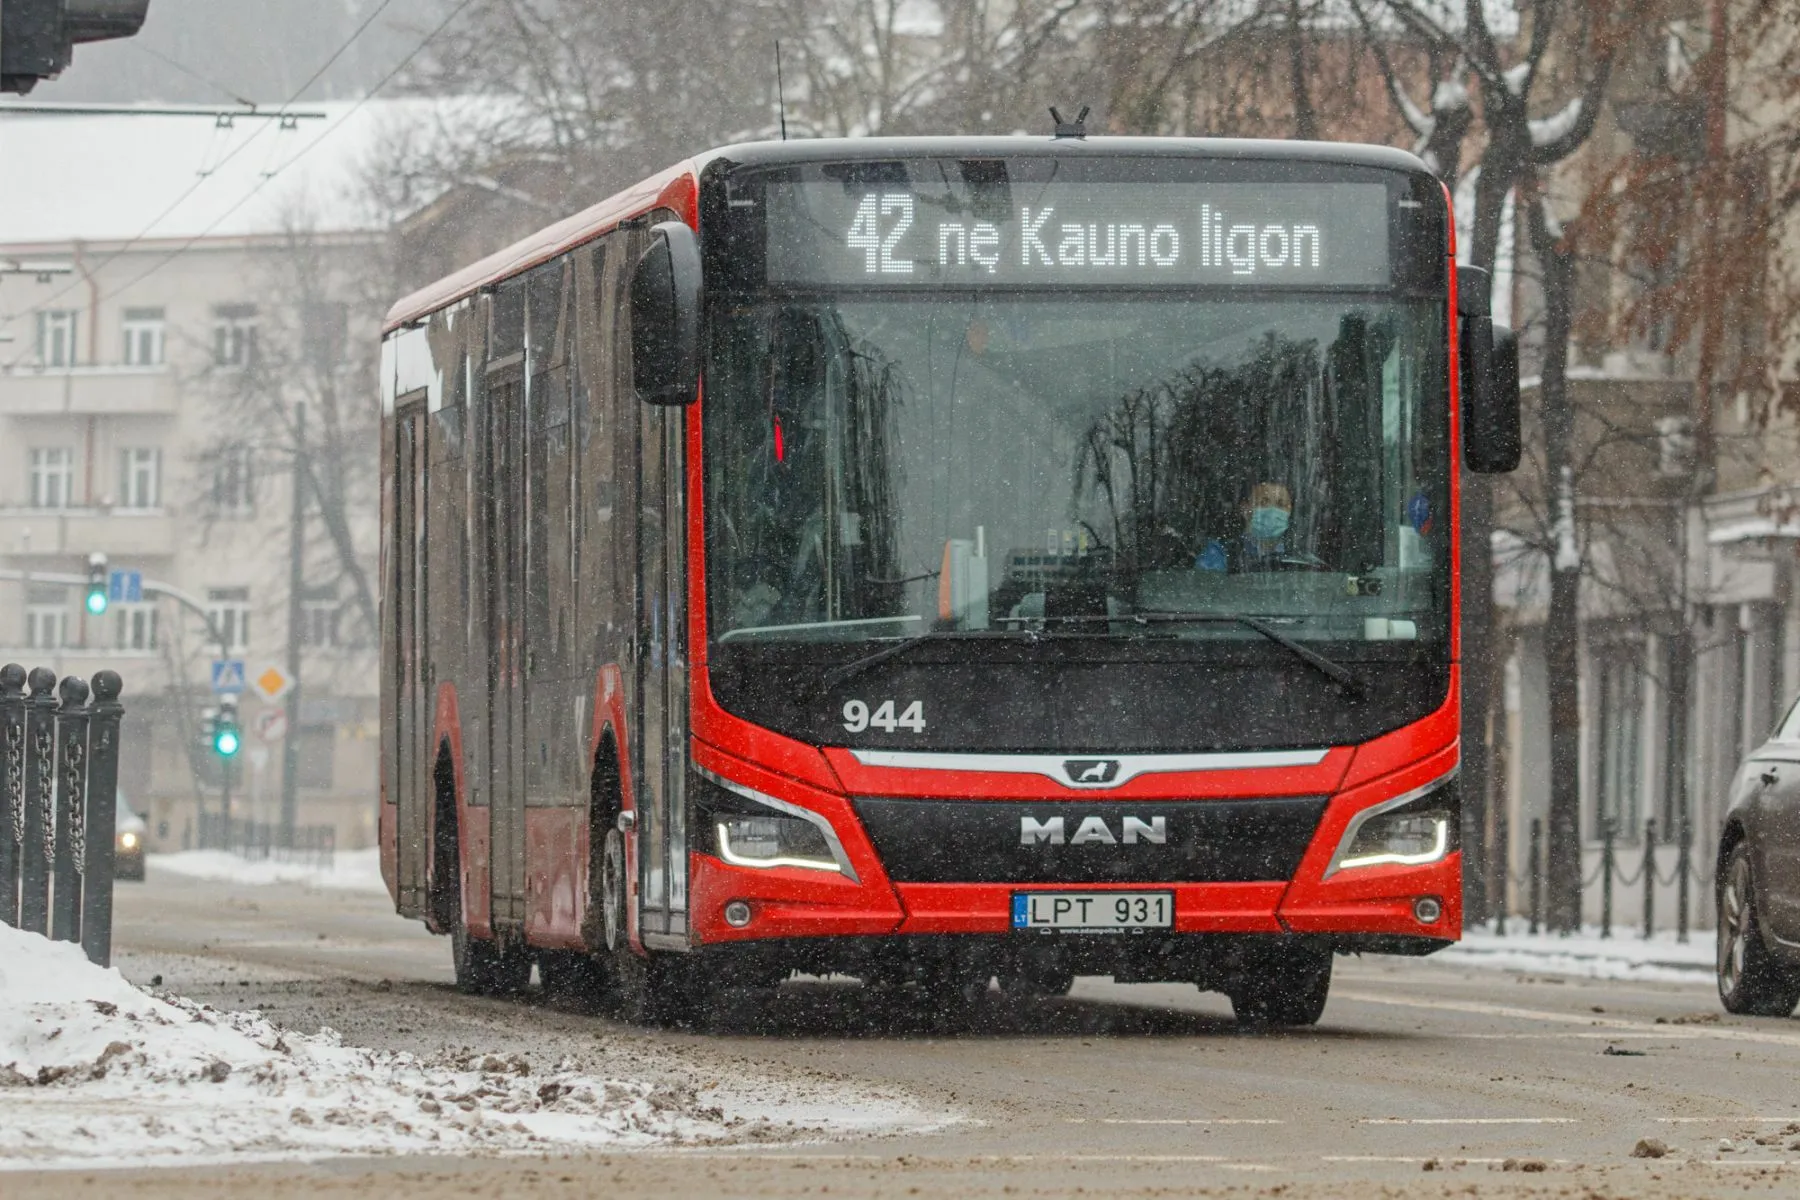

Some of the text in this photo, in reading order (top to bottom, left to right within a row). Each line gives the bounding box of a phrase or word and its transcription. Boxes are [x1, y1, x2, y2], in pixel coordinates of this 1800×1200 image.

[847, 193, 1320, 275] 42 nę Kauno ligon
[842, 699, 927, 733] 944
[1020, 816, 1167, 844] MAN
[1014, 914, 1026, 923] LT
[1032, 898, 1164, 923] LPT 931
